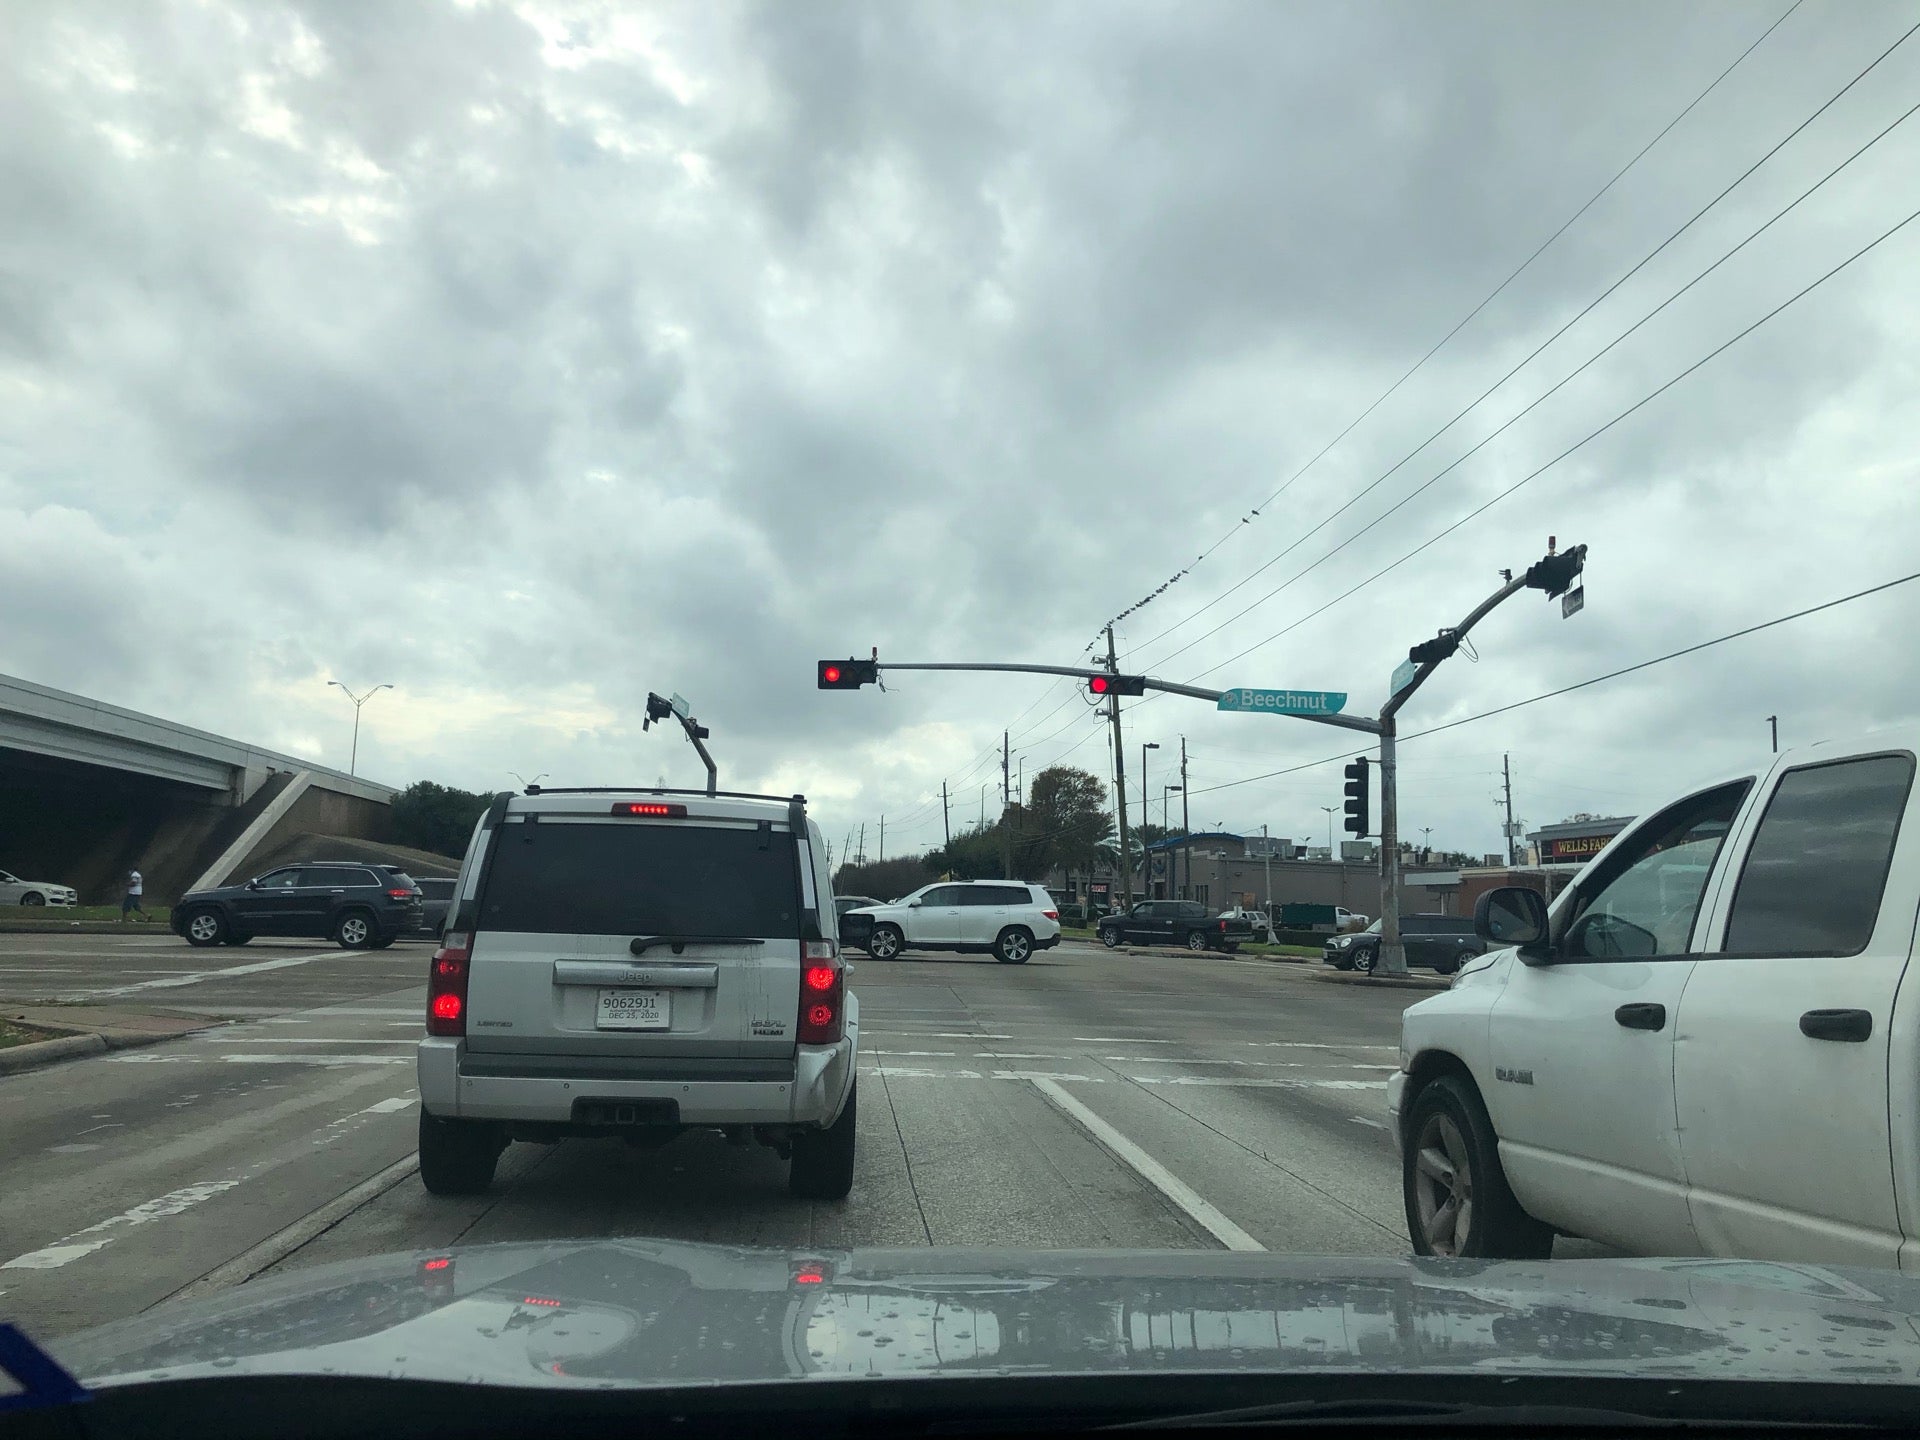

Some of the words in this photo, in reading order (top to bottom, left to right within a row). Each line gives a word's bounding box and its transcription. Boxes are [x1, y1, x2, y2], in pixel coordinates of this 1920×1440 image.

[1241, 690, 1327, 709] Beechnut
[1558, 839, 1588, 853] WELLS
[618, 970, 652, 983] Jeep
[603, 997, 656, 1009] 90629J1
